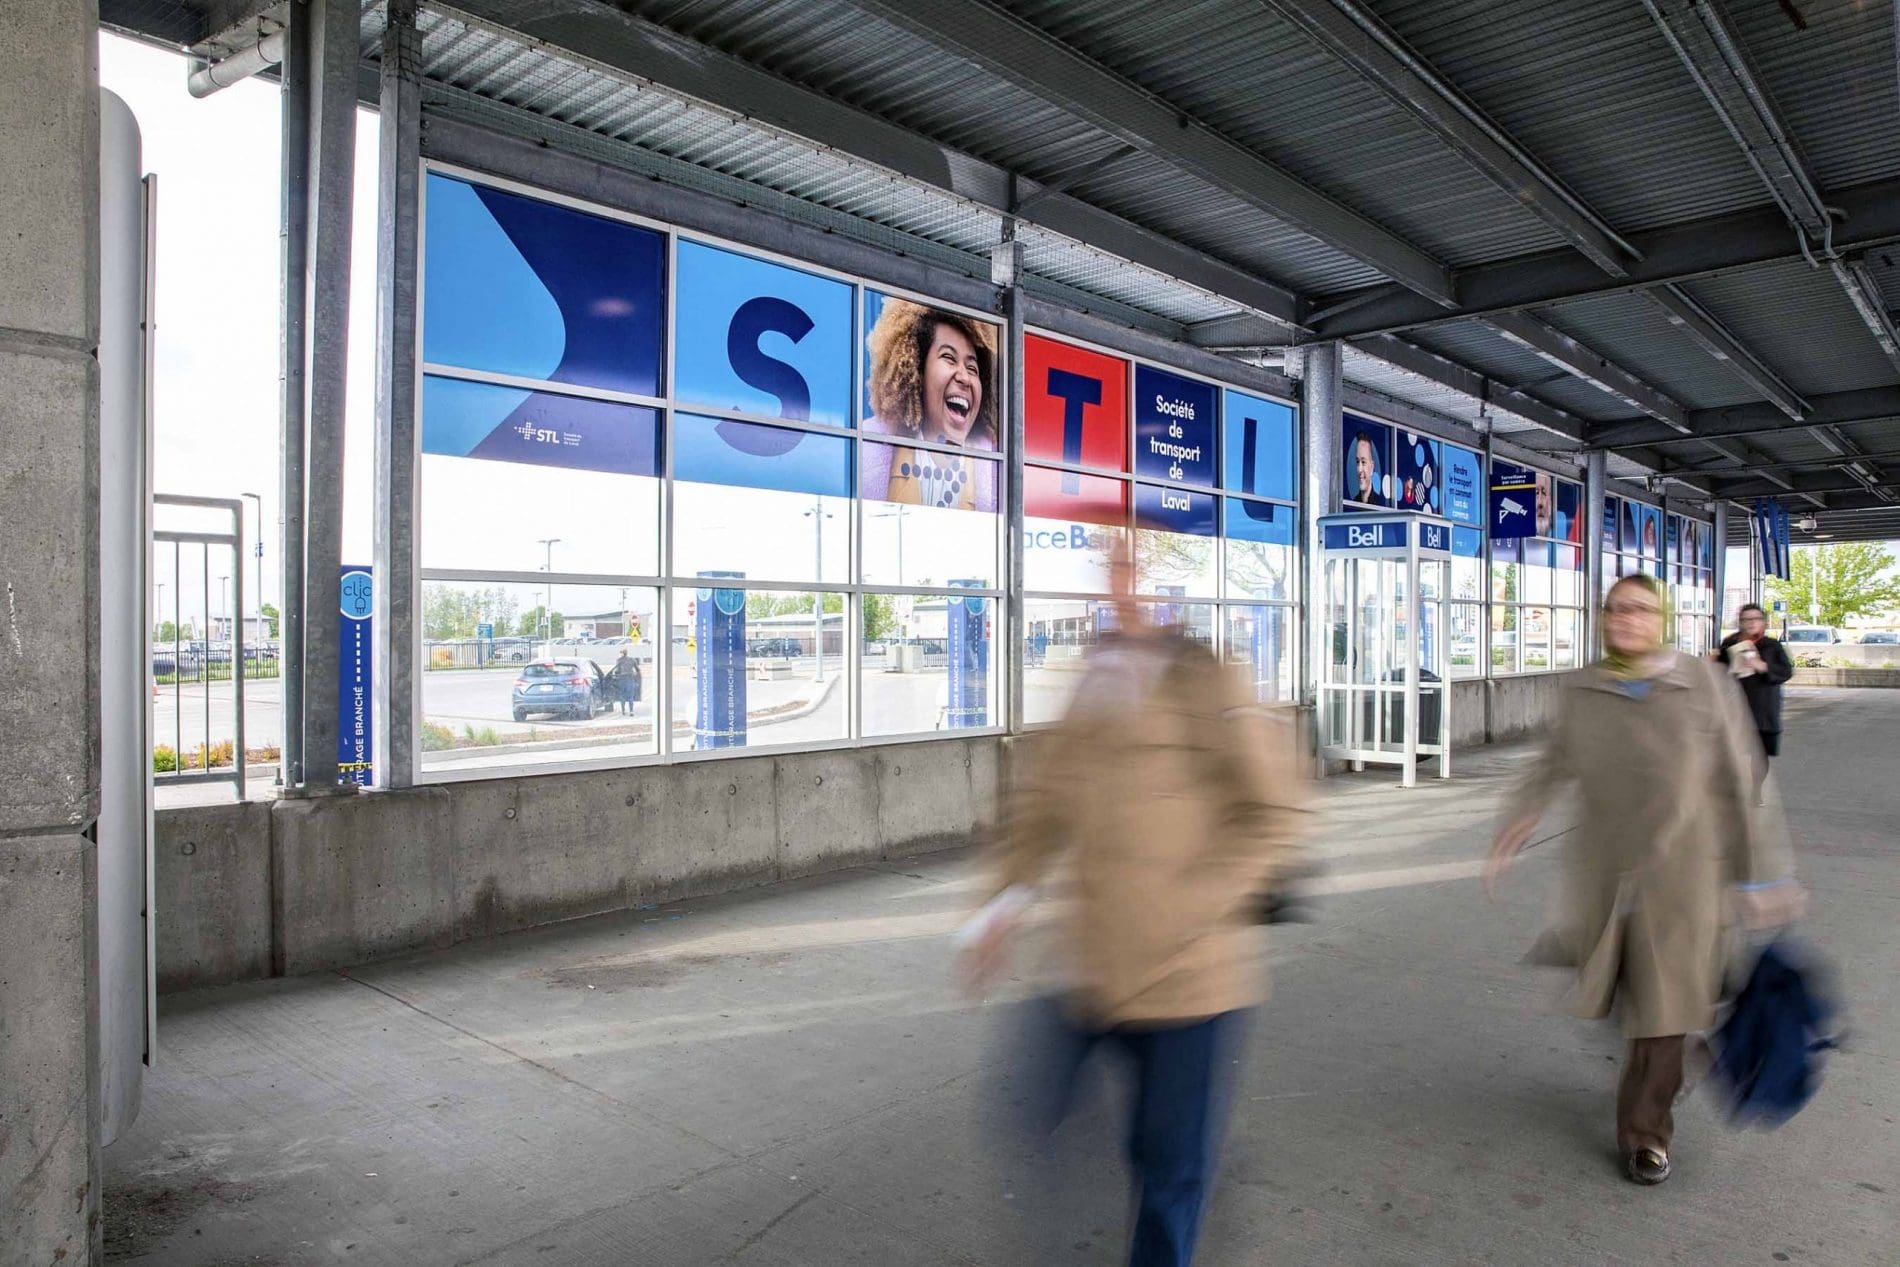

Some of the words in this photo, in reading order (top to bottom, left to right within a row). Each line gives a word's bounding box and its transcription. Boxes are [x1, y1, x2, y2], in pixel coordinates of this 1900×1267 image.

[714, 296, 815, 457] S
[1156, 395, 1195, 420] Société
[536, 429, 560, 444] STL
[1047, 367, 1102, 495] T
[1169, 420, 1183, 439] de
[1150, 436, 1201, 463] transport
[1169, 461, 1183, 480] de
[1242, 417, 1274, 523] L
[1162, 490, 1191, 511] Laval
[1348, 525, 1383, 547] Bell
[1427, 526, 1441, 548] Bell
[343, 578, 373, 597] clic
[353, 686, 364, 736] BRANCHÉ
